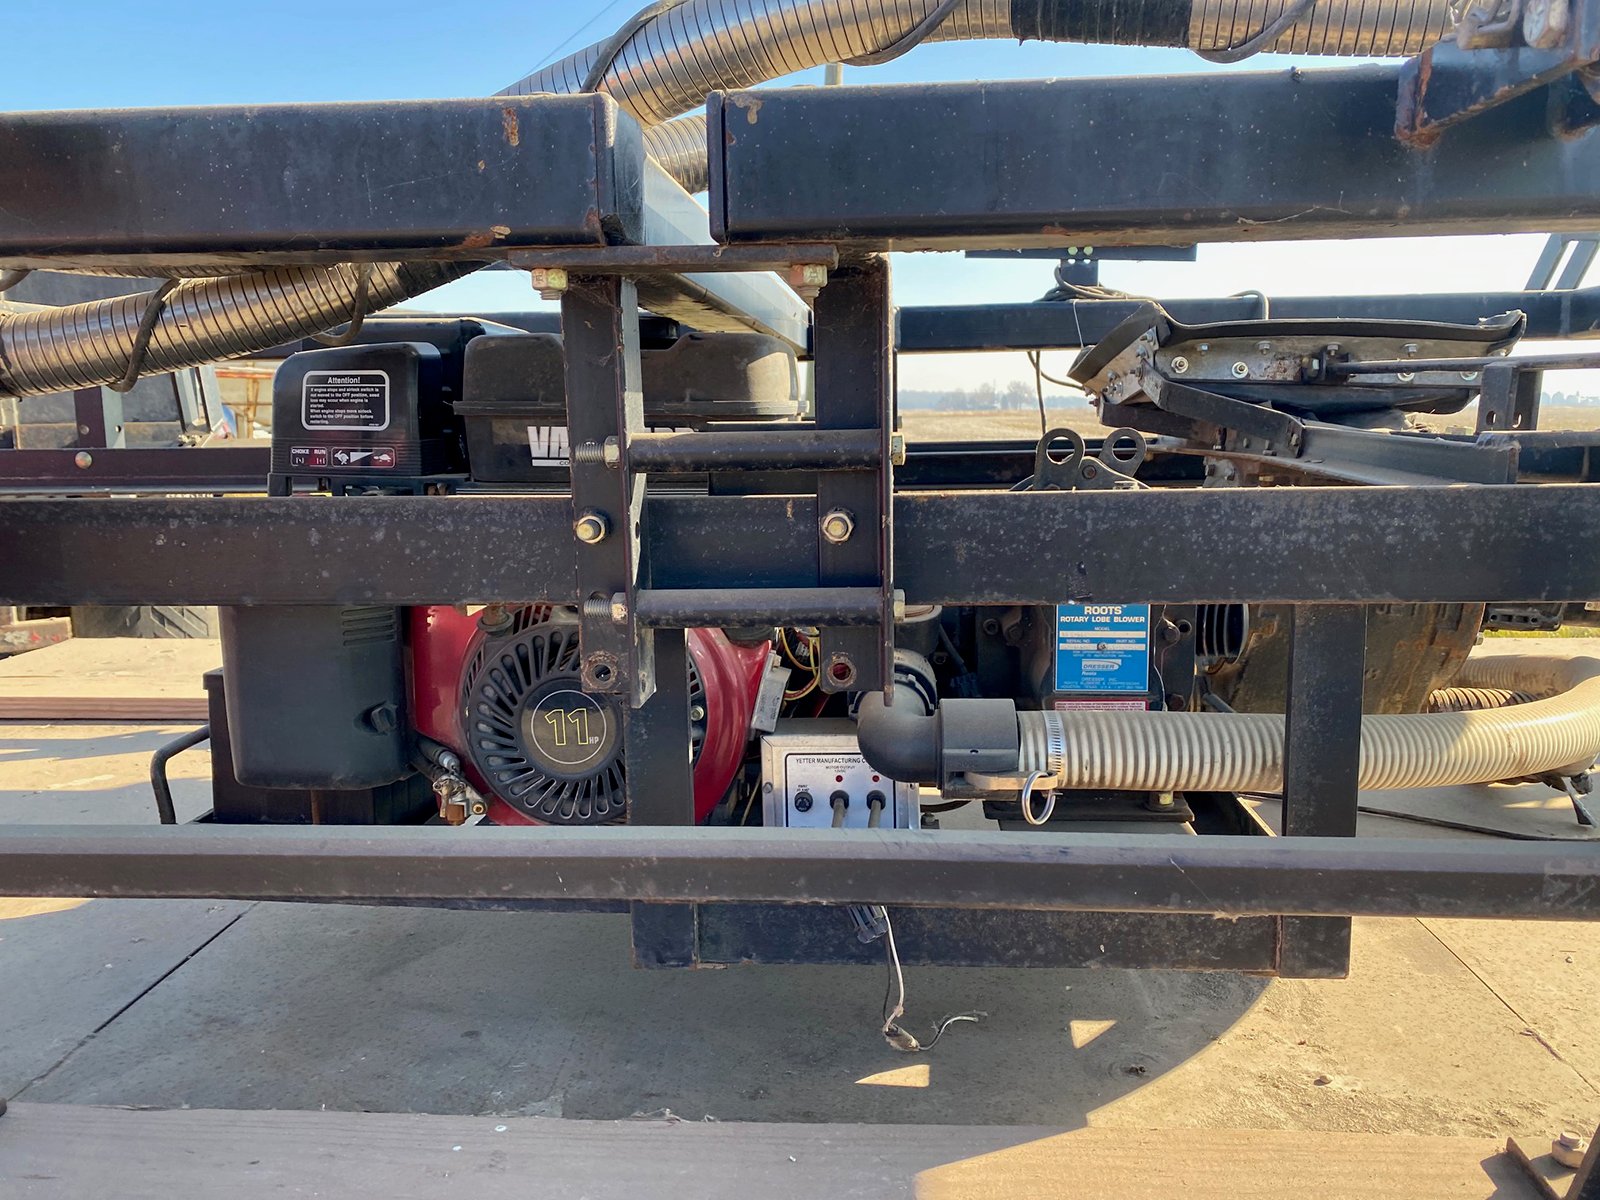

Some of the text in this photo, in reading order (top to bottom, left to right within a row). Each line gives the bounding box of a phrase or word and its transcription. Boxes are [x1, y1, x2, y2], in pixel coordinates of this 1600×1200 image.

[1084, 606, 1122, 615] ROOTS
[544, 708, 599, 746] 11 HP
